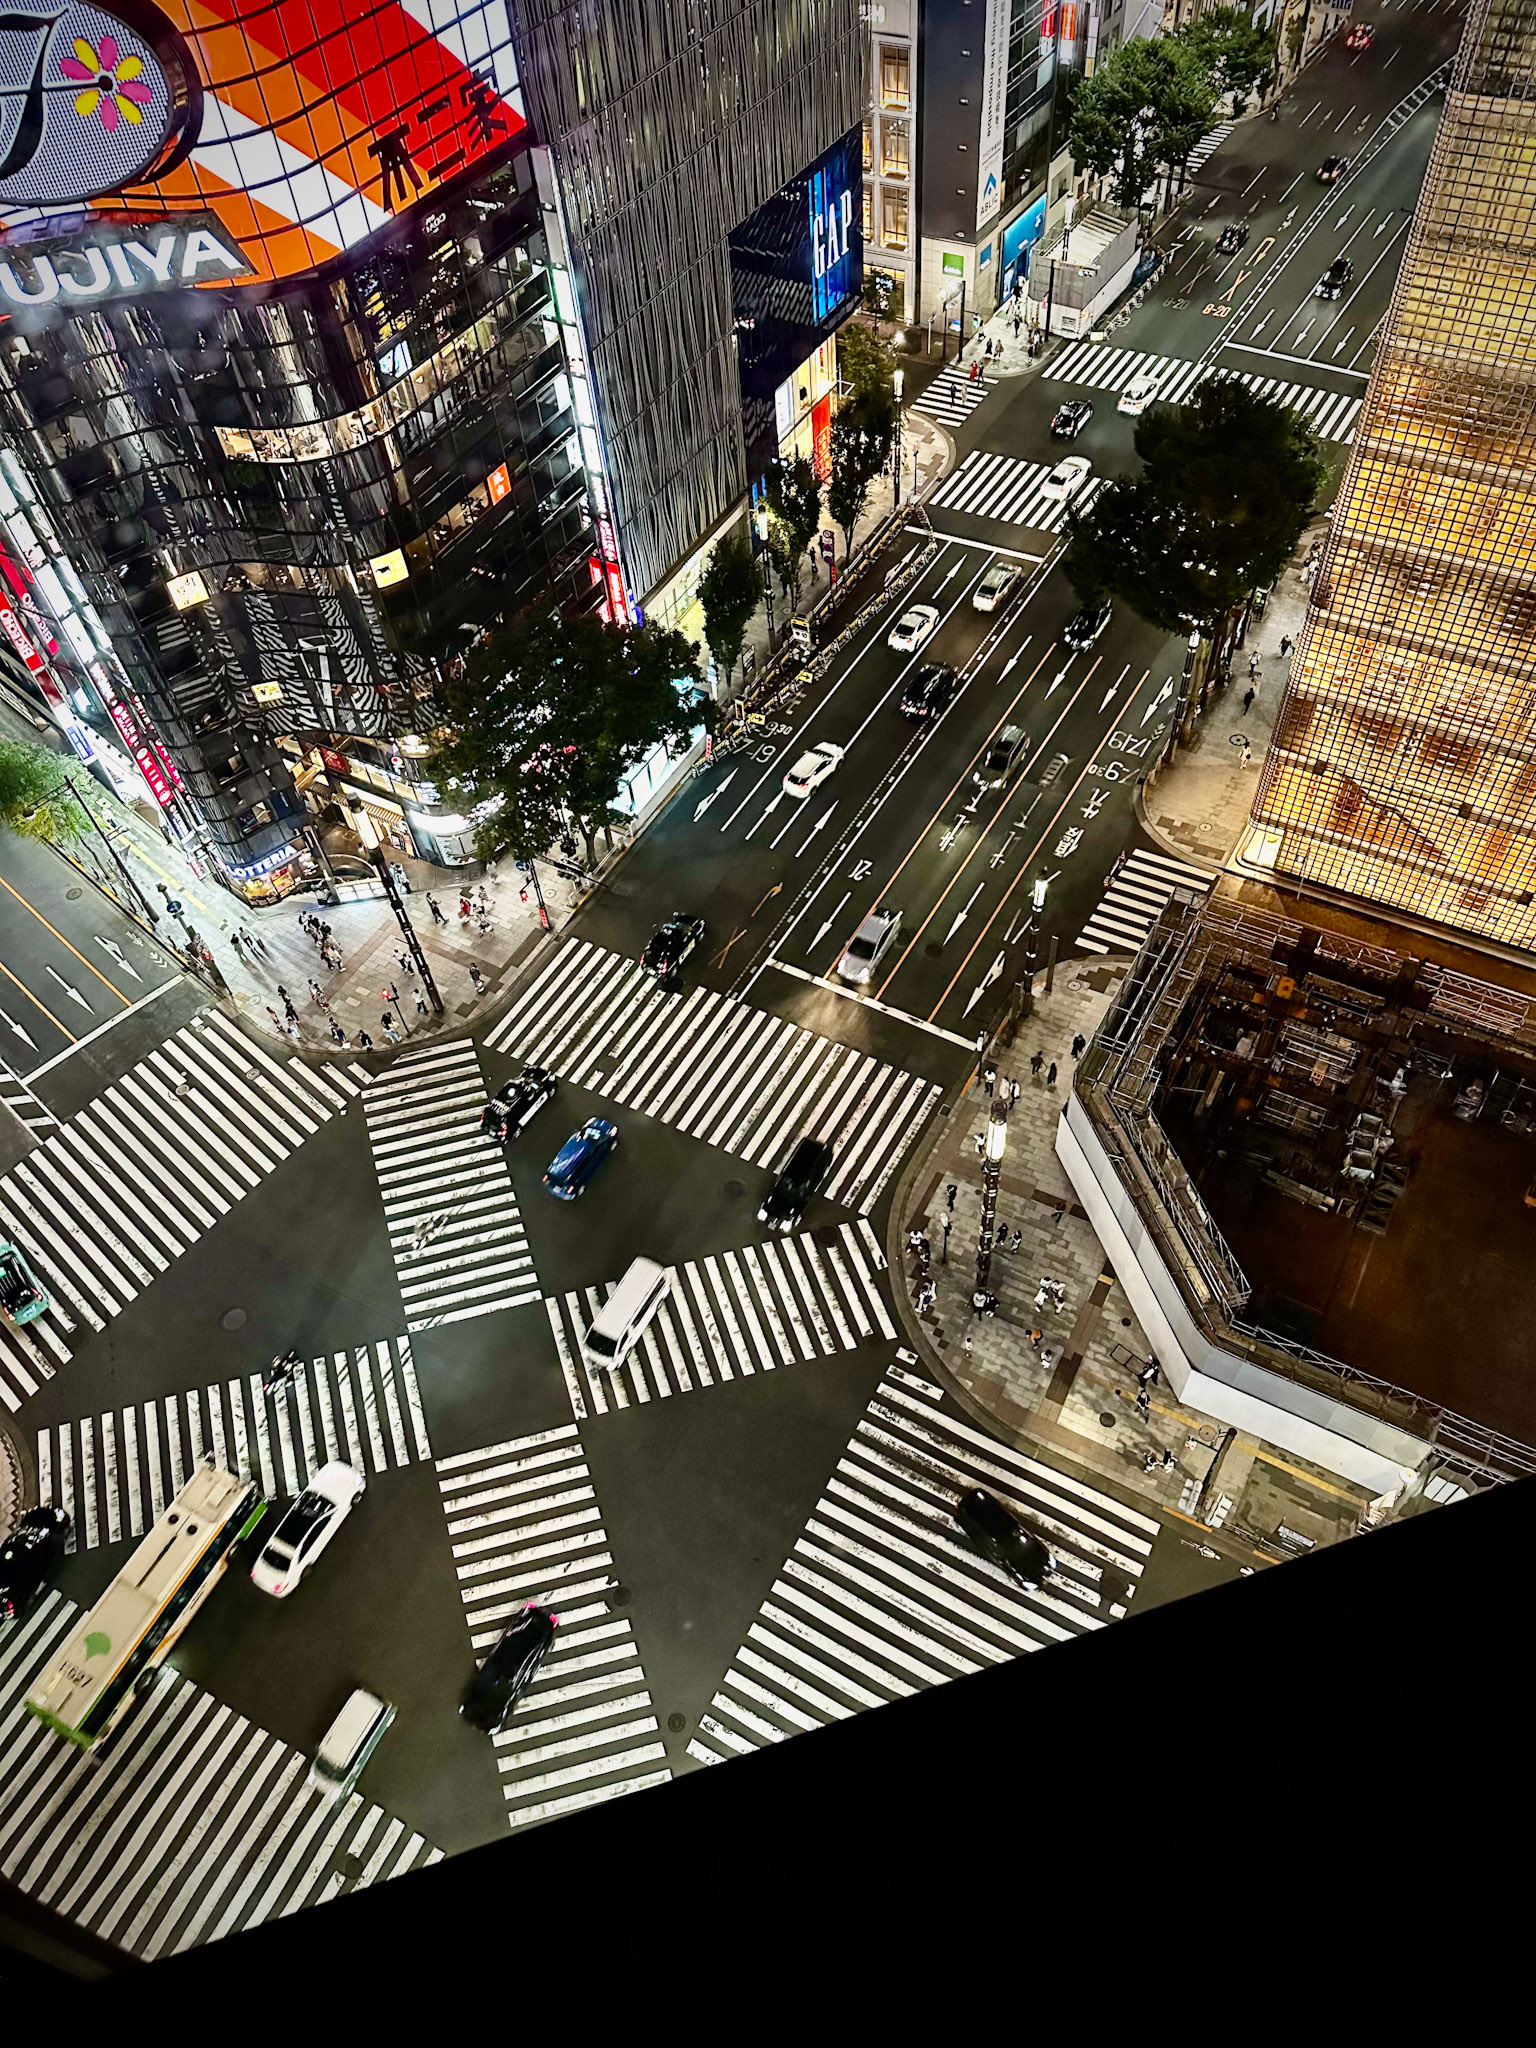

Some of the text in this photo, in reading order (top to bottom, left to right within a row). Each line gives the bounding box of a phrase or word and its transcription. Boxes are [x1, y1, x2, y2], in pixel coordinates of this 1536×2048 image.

[367, 65, 507, 213] 不二家
[980, 193, 999, 216] ABLIC
[813, 189, 853, 279] GAP
[1202, 303, 1232, 318] 8-20
[225, 844, 298, 878] LOTTERIA
